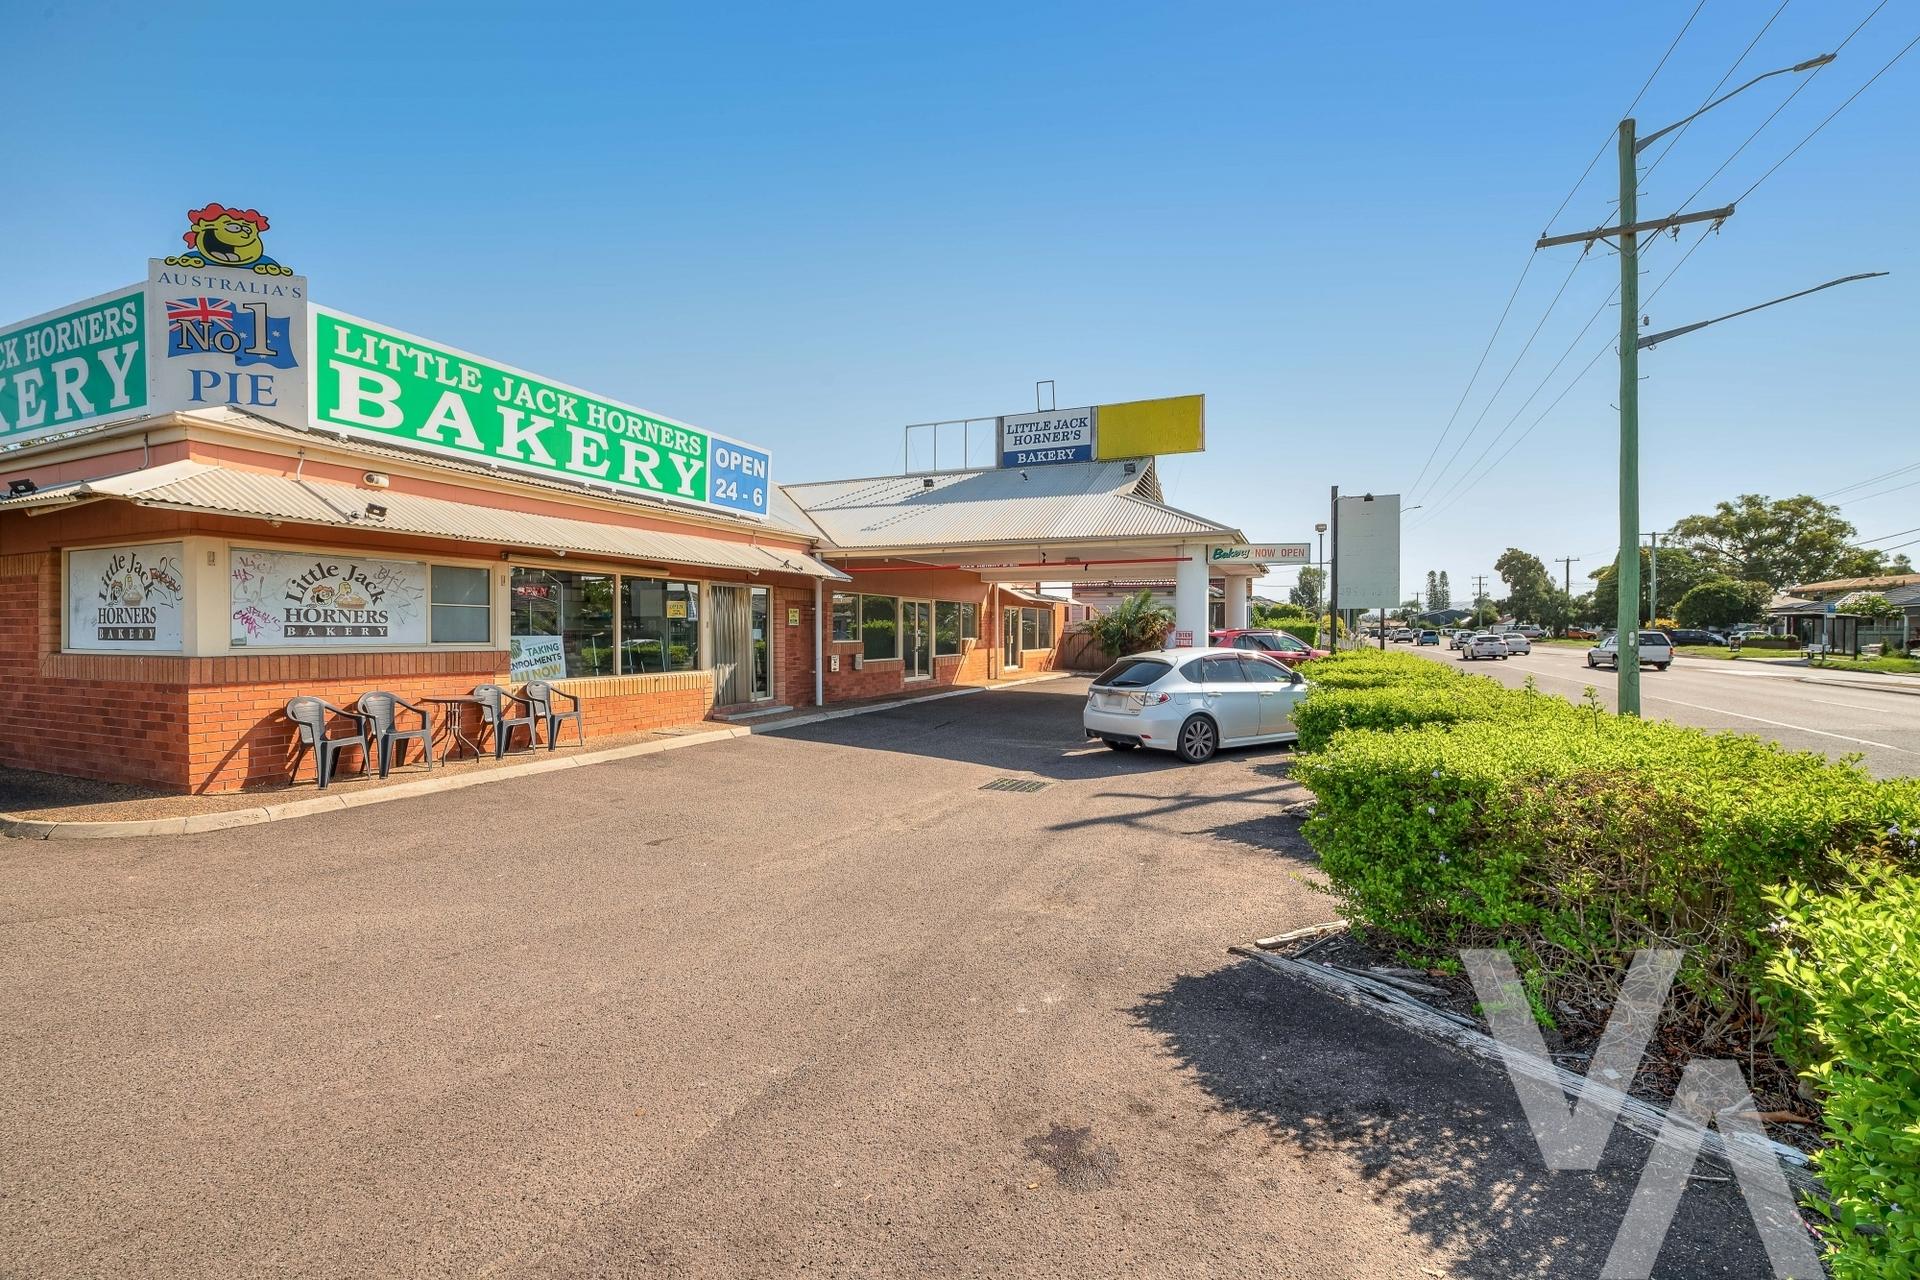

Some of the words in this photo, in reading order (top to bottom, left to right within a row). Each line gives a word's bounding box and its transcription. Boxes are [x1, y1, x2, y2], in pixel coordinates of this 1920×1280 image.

[158, 272, 302, 299] AUSTRALIA'S
[25, 301, 137, 363] HORNERS
[0, 340, 139, 432] ERY
[187, 368, 278, 407] PIE
[334, 324, 483, 394] LITTLE
[493, 377, 578, 422] JACK
[587, 403, 701, 456] HORNERS
[329, 359, 704, 497] BAKERY
[1006, 420, 1051, 435] LITTLE
[1054, 417, 1088, 430] JACK
[1013, 430, 1081, 446] HORNER'S
[715, 448, 766, 479] OPEN
[1017, 448, 1076, 464] BAKERY
[715, 478, 738, 501] 24
[753, 487, 763, 507] 6
[1213, 547, 1250, 560] Bakery
[1255, 548, 1276, 558] NOW
[1281, 548, 1305, 557] OPEN
[99, 554, 125, 601] Little
[127, 552, 155, 600] Jack
[285, 562, 339, 604] Little
[342, 564, 386, 606] Jack
[98, 606, 157, 624] HORNERS
[283, 607, 388, 624] HORNERS
[99, 628, 155, 640] BAKERY
[287, 627, 386, 636] BAKERY
[525, 643, 560, 656] TAKING
[511, 653, 562, 671] NROLMENTS
[532, 664, 561, 680] NOW
